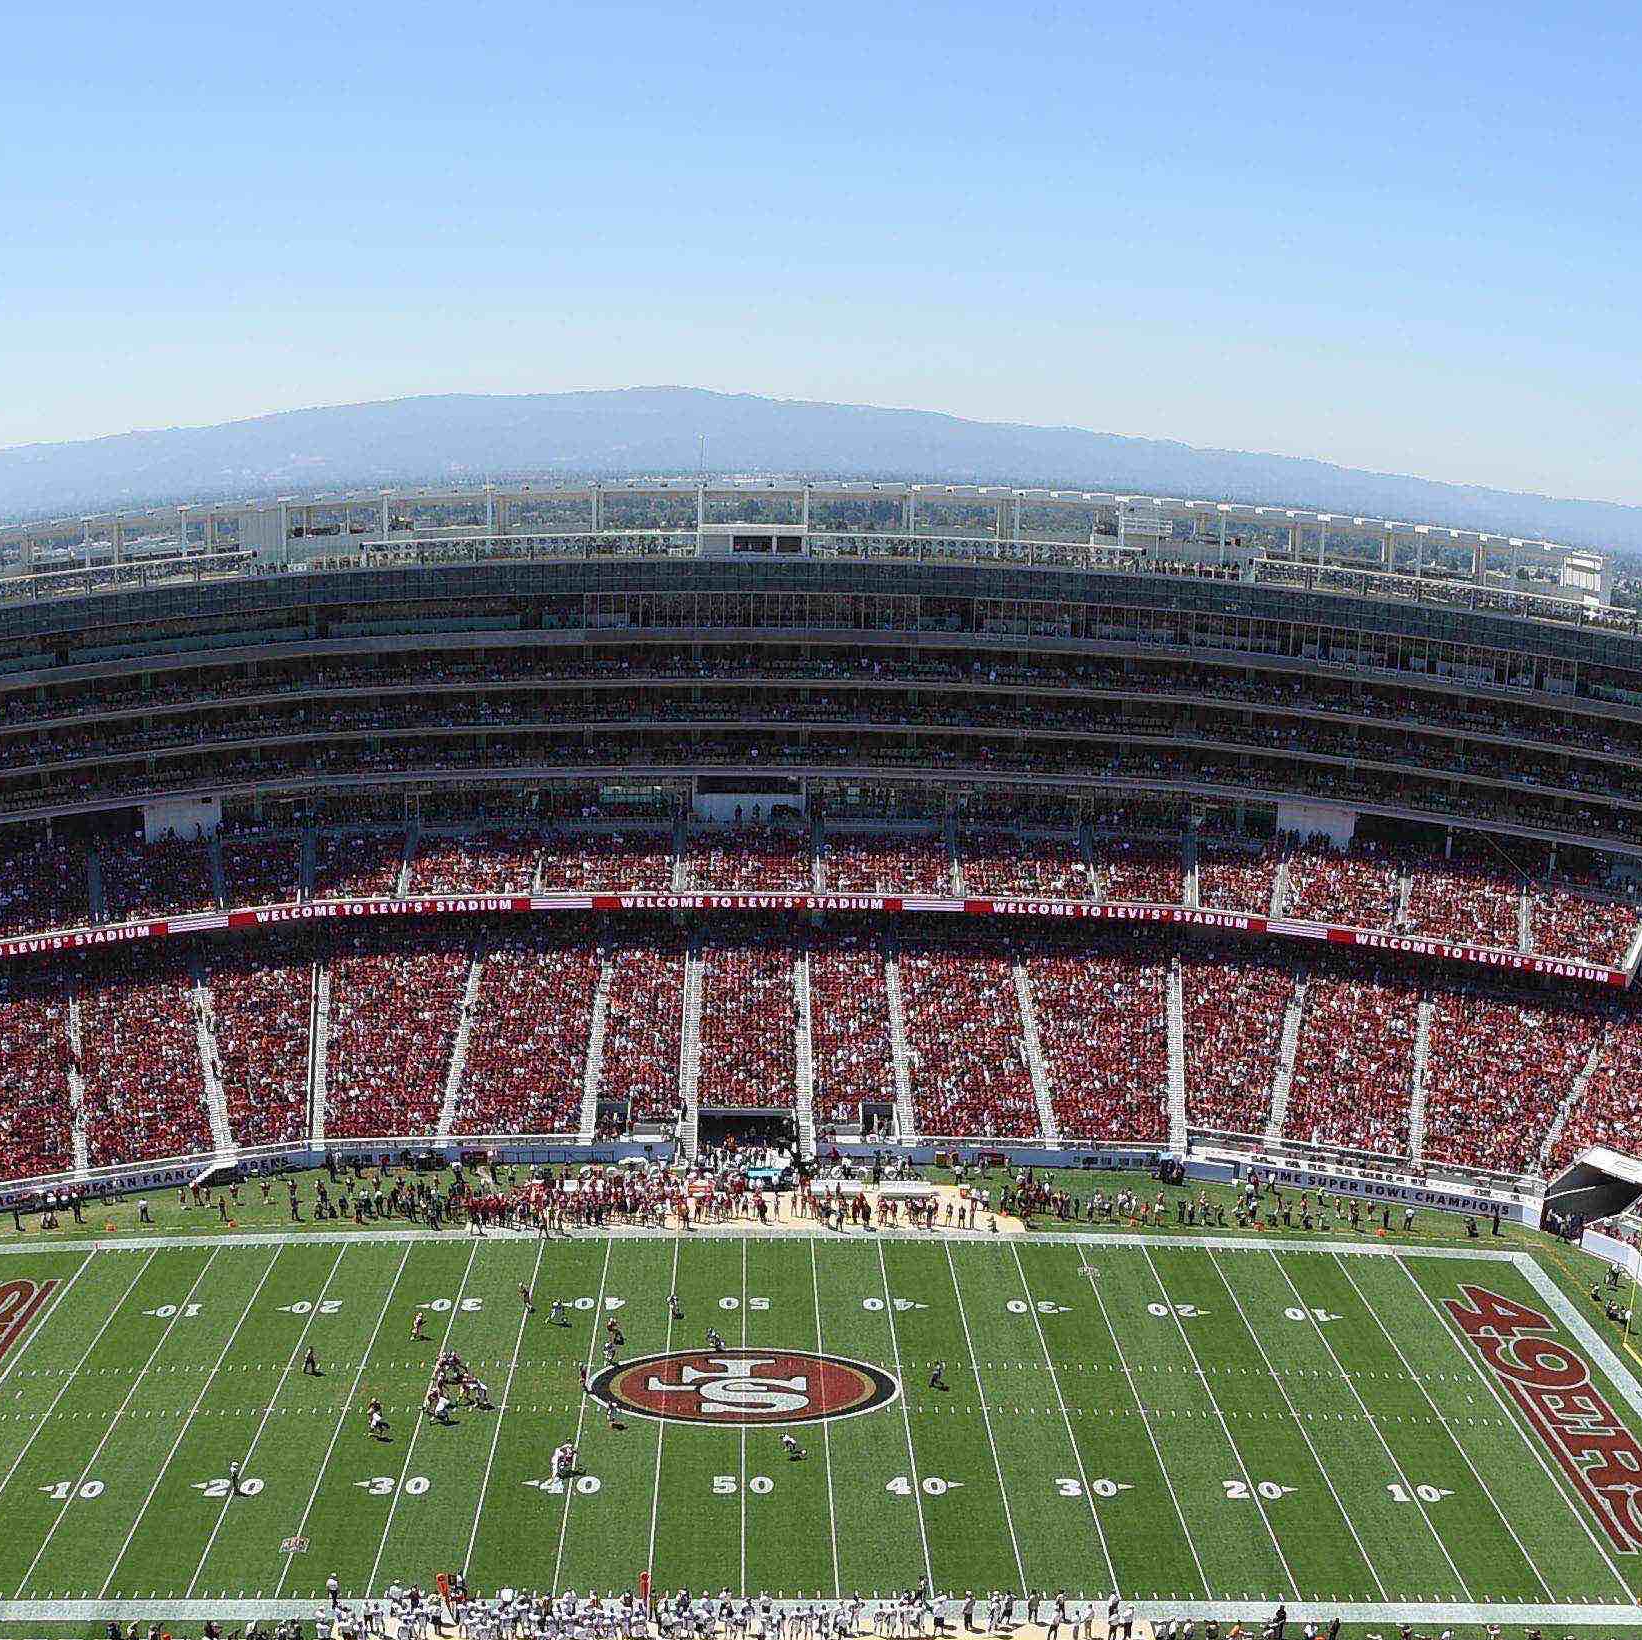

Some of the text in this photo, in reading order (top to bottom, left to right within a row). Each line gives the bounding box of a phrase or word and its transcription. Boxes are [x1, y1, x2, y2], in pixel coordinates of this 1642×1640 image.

[257, 904, 337, 923] WELCOME
[343, 903, 364, 915] TO
[436, 899, 512, 912] STADIUM
[620, 897, 704, 908] WELCOME
[711, 897, 732, 908] TO
[806, 897, 884, 910] STADIUM
[992, 902, 1074, 916] WELCOME
[1080, 905, 1101, 917] TO
[1173, 910, 1248, 930] STADIUM
[75, 925, 150, 946] STADIUM
[1355, 933, 1436, 954] WELCOME
[1443, 945, 1463, 959] TO
[1534, 960, 1609, 983] STADIUM
[1308, 1174, 1358, 1191] SUPER
[1364, 1184, 1410, 1200] BOWL
[1415, 1191, 1510, 1215] CHAMPIONS
[51, 1480, 106, 1500] 10
[204, 1478, 266, 1497] 20
[368, 1477, 431, 1496] 30
[712, 1475, 775, 1495] 50
[885, 1475, 948, 1496] 40
[1055, 1478, 1118, 1498] 30
[1222, 1479, 1283, 1500] 20
[1386, 1482, 1442, 1503] 10
